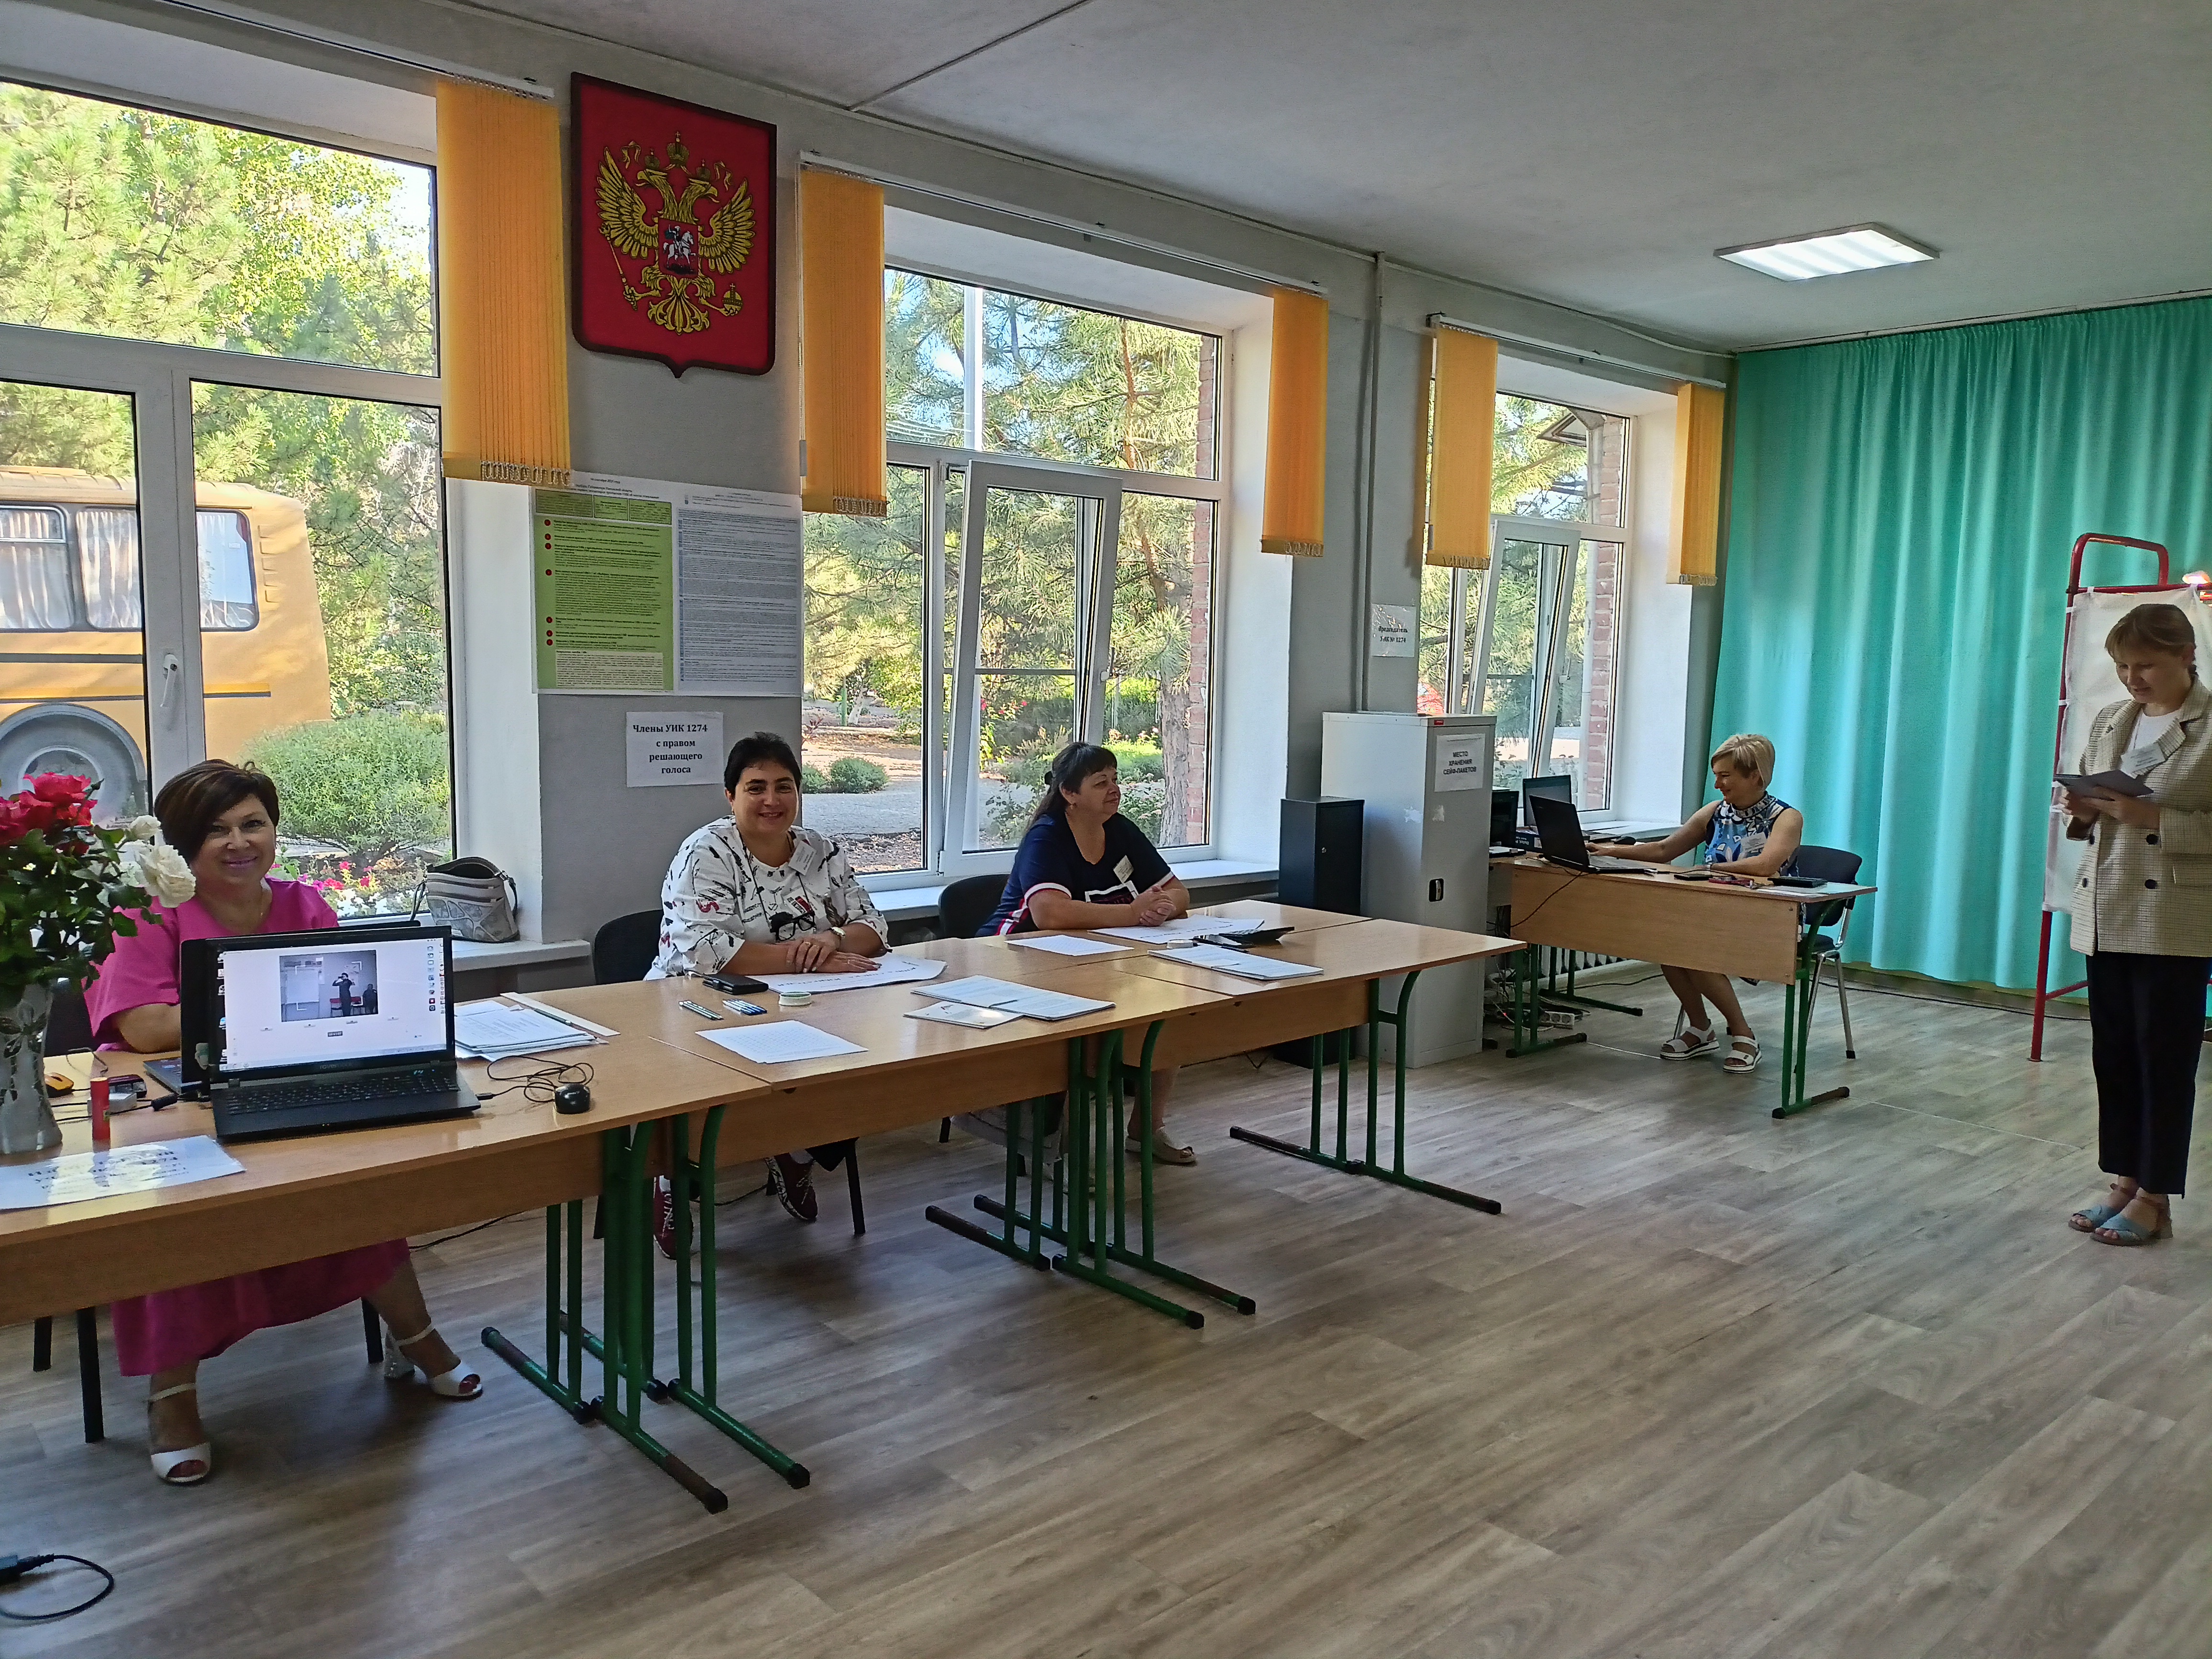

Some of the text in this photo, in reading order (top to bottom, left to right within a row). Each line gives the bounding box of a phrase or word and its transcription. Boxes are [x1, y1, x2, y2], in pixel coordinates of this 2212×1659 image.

[663, 741, 695, 749] правом
[649, 753, 702, 763] решающего
[1443, 766, 1476, 775] СЕЙФ-ПАКЕТОВ
